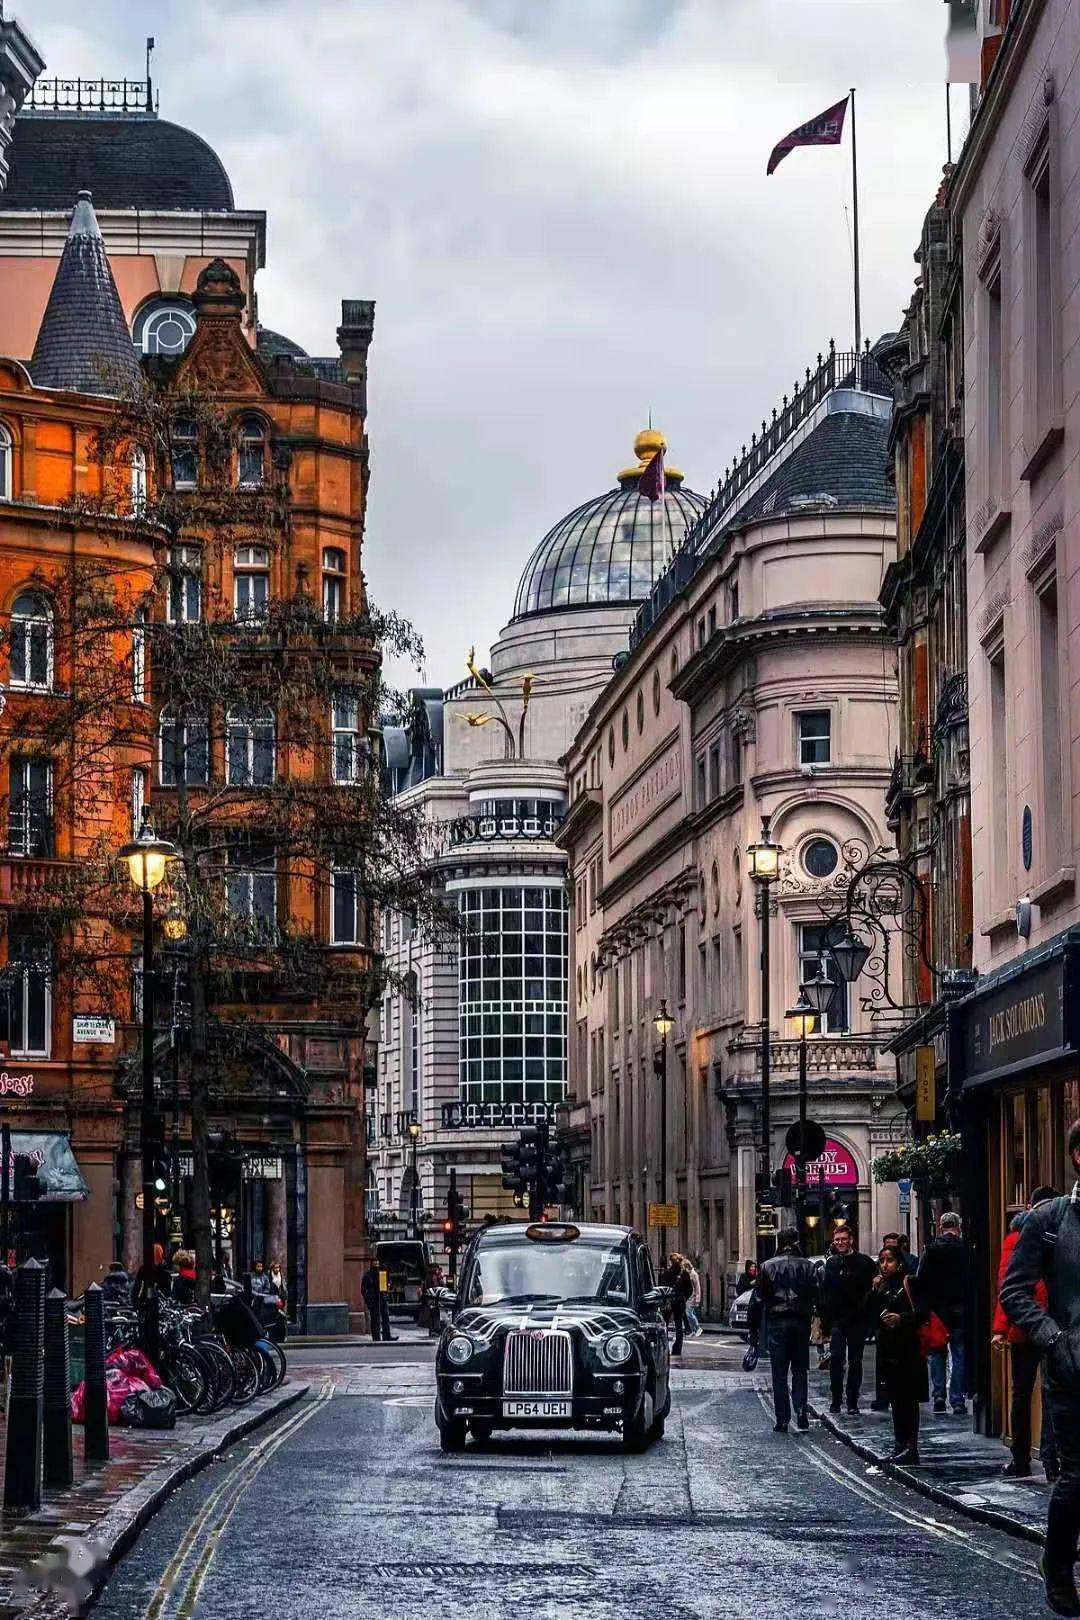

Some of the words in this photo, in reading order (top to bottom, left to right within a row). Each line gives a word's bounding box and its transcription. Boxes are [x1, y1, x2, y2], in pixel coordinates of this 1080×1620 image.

[989, 1010, 1005, 1054] JACK
[507, 1403, 540, 1415] LP64
[542, 1403, 567, 1415] UEH
